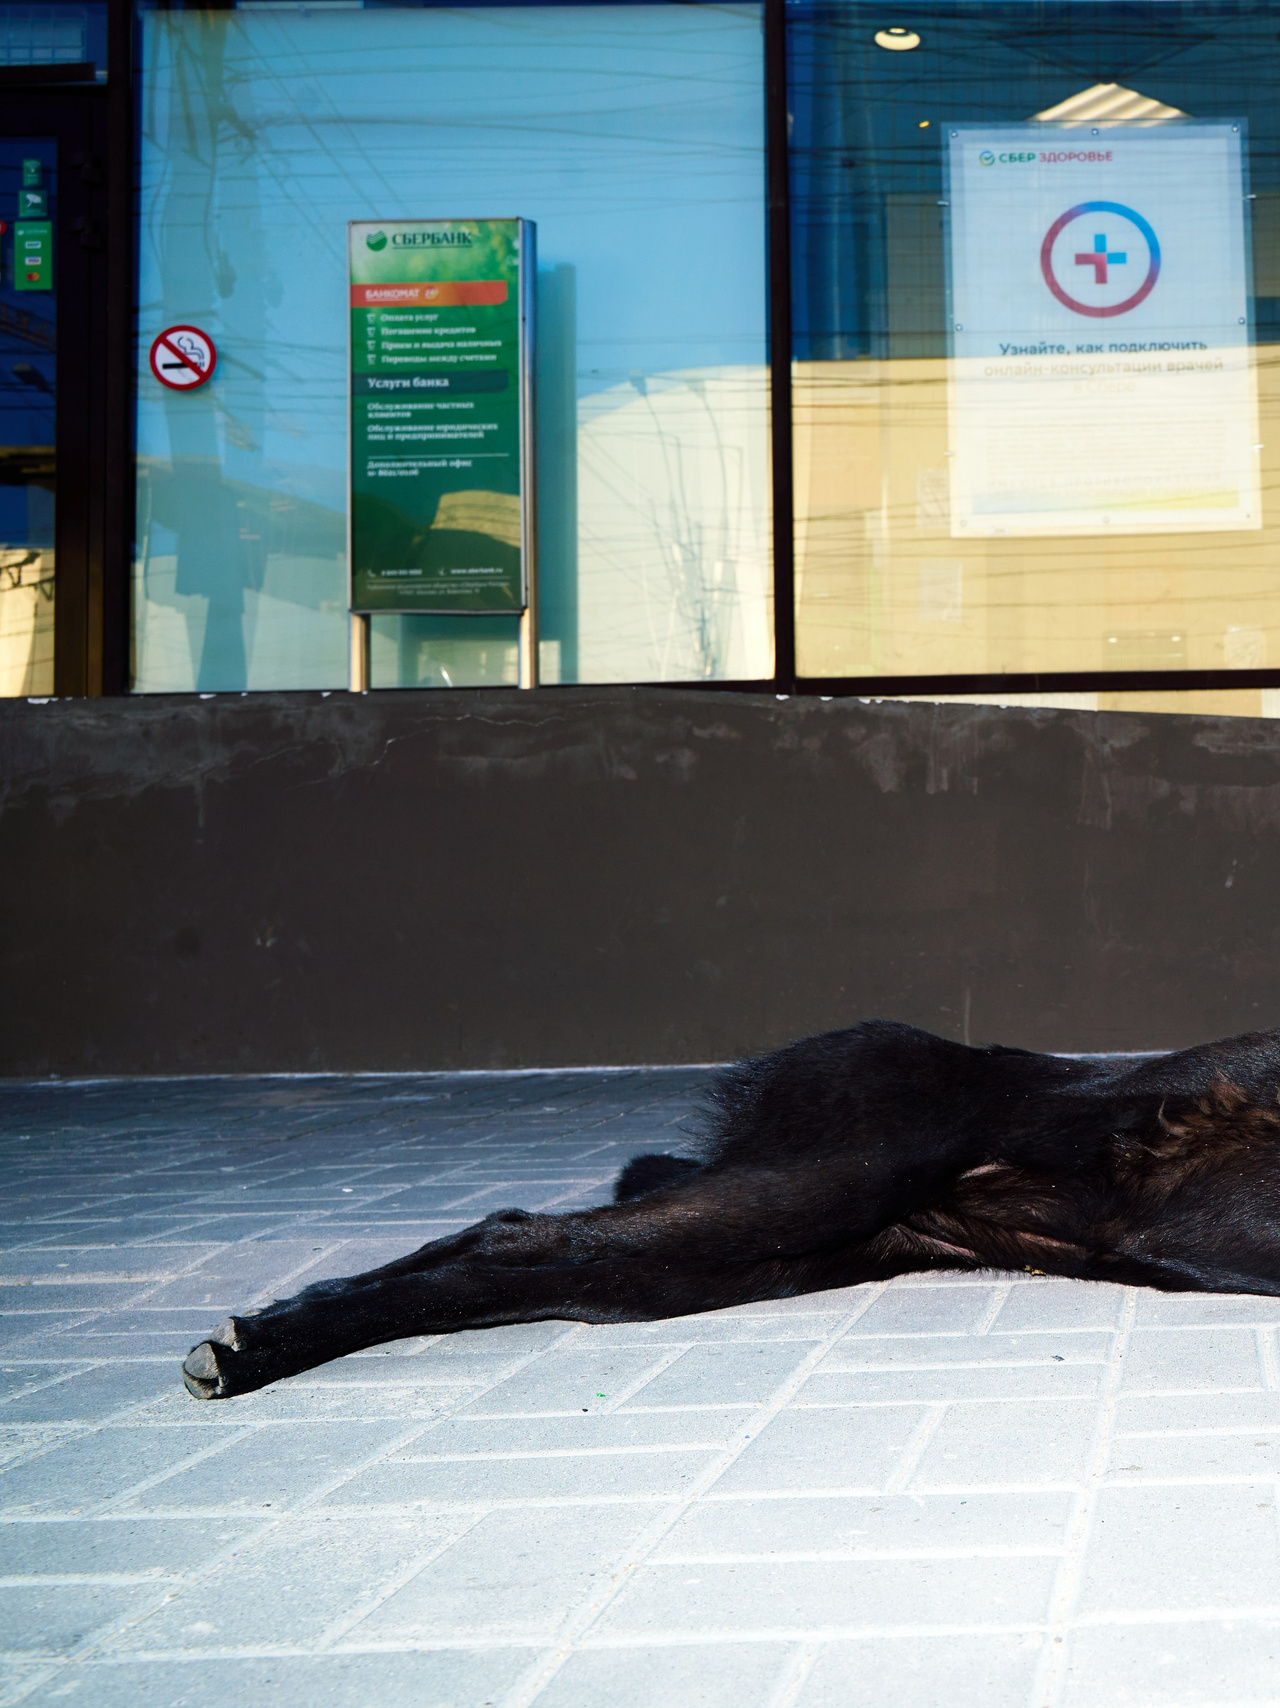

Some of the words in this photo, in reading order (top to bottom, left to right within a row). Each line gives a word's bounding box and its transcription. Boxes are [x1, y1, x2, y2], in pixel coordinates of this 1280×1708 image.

[999, 151, 1036, 163] СБЕР
[1038, 150, 1113, 163] ЗДОРОВЬЕ
[392, 231, 472, 246] СБЕРБАНК
[365, 289, 420, 300] БАНКОМАТ
[380, 314, 413, 322] Оплата
[415, 314, 439, 323] услуг
[381, 327, 432, 336] Погашение
[434, 326, 477, 336] кредитов
[422, 341, 454, 349] выдача
[456, 339, 502, 348] наличных
[999, 342, 1071, 356] Узнайте,
[1076, 344, 1104, 354] как
[1108, 339, 1208, 355] подключить
[381, 355, 427, 365] Переводы
[428, 355, 458, 364] между
[984, 361, 1162, 377] онлайн-консультации
[1166, 358, 1224, 373] врачей
[368, 378, 411, 392] Услуги
[412, 376, 449, 388] банка
[367, 402, 434, 412] Обслуживание
[435, 401, 475, 410] частных
[367, 411, 412, 419] клиентов
[367, 424, 434, 434] Обслуживание
[436, 423, 499, 432] юридических
[367, 434, 386, 442] лиц
[395, 431, 485, 442] предпринимателей
[367, 460, 447, 470] Дополнительный
[449, 459, 472, 469] офис
